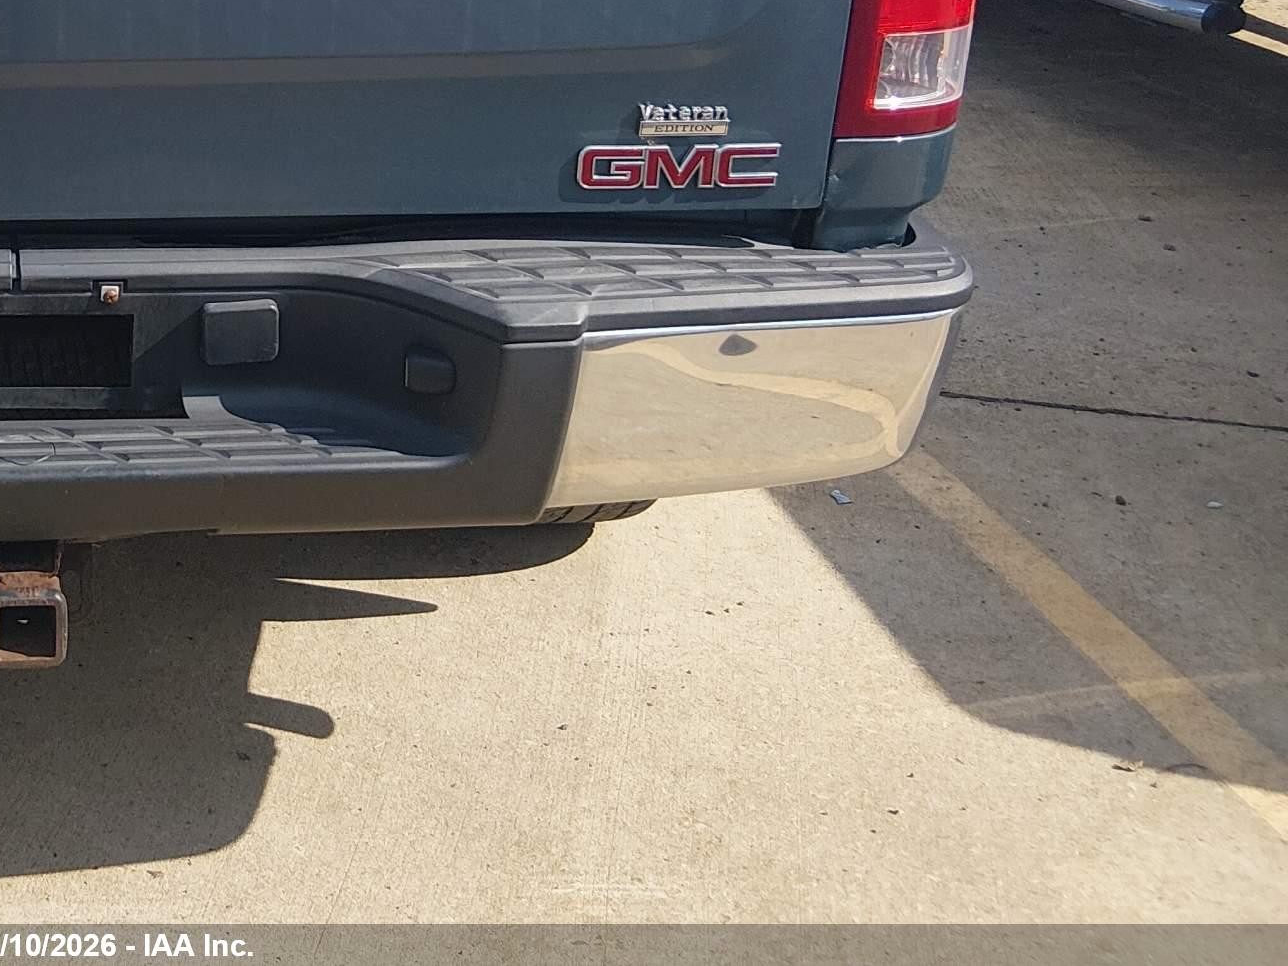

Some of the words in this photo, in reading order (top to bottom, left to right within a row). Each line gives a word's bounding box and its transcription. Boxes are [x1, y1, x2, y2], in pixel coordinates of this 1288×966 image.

[639, 102, 729, 121] Veteran
[654, 124, 714, 133] EDITION
[577, 143, 783, 190] GMC
